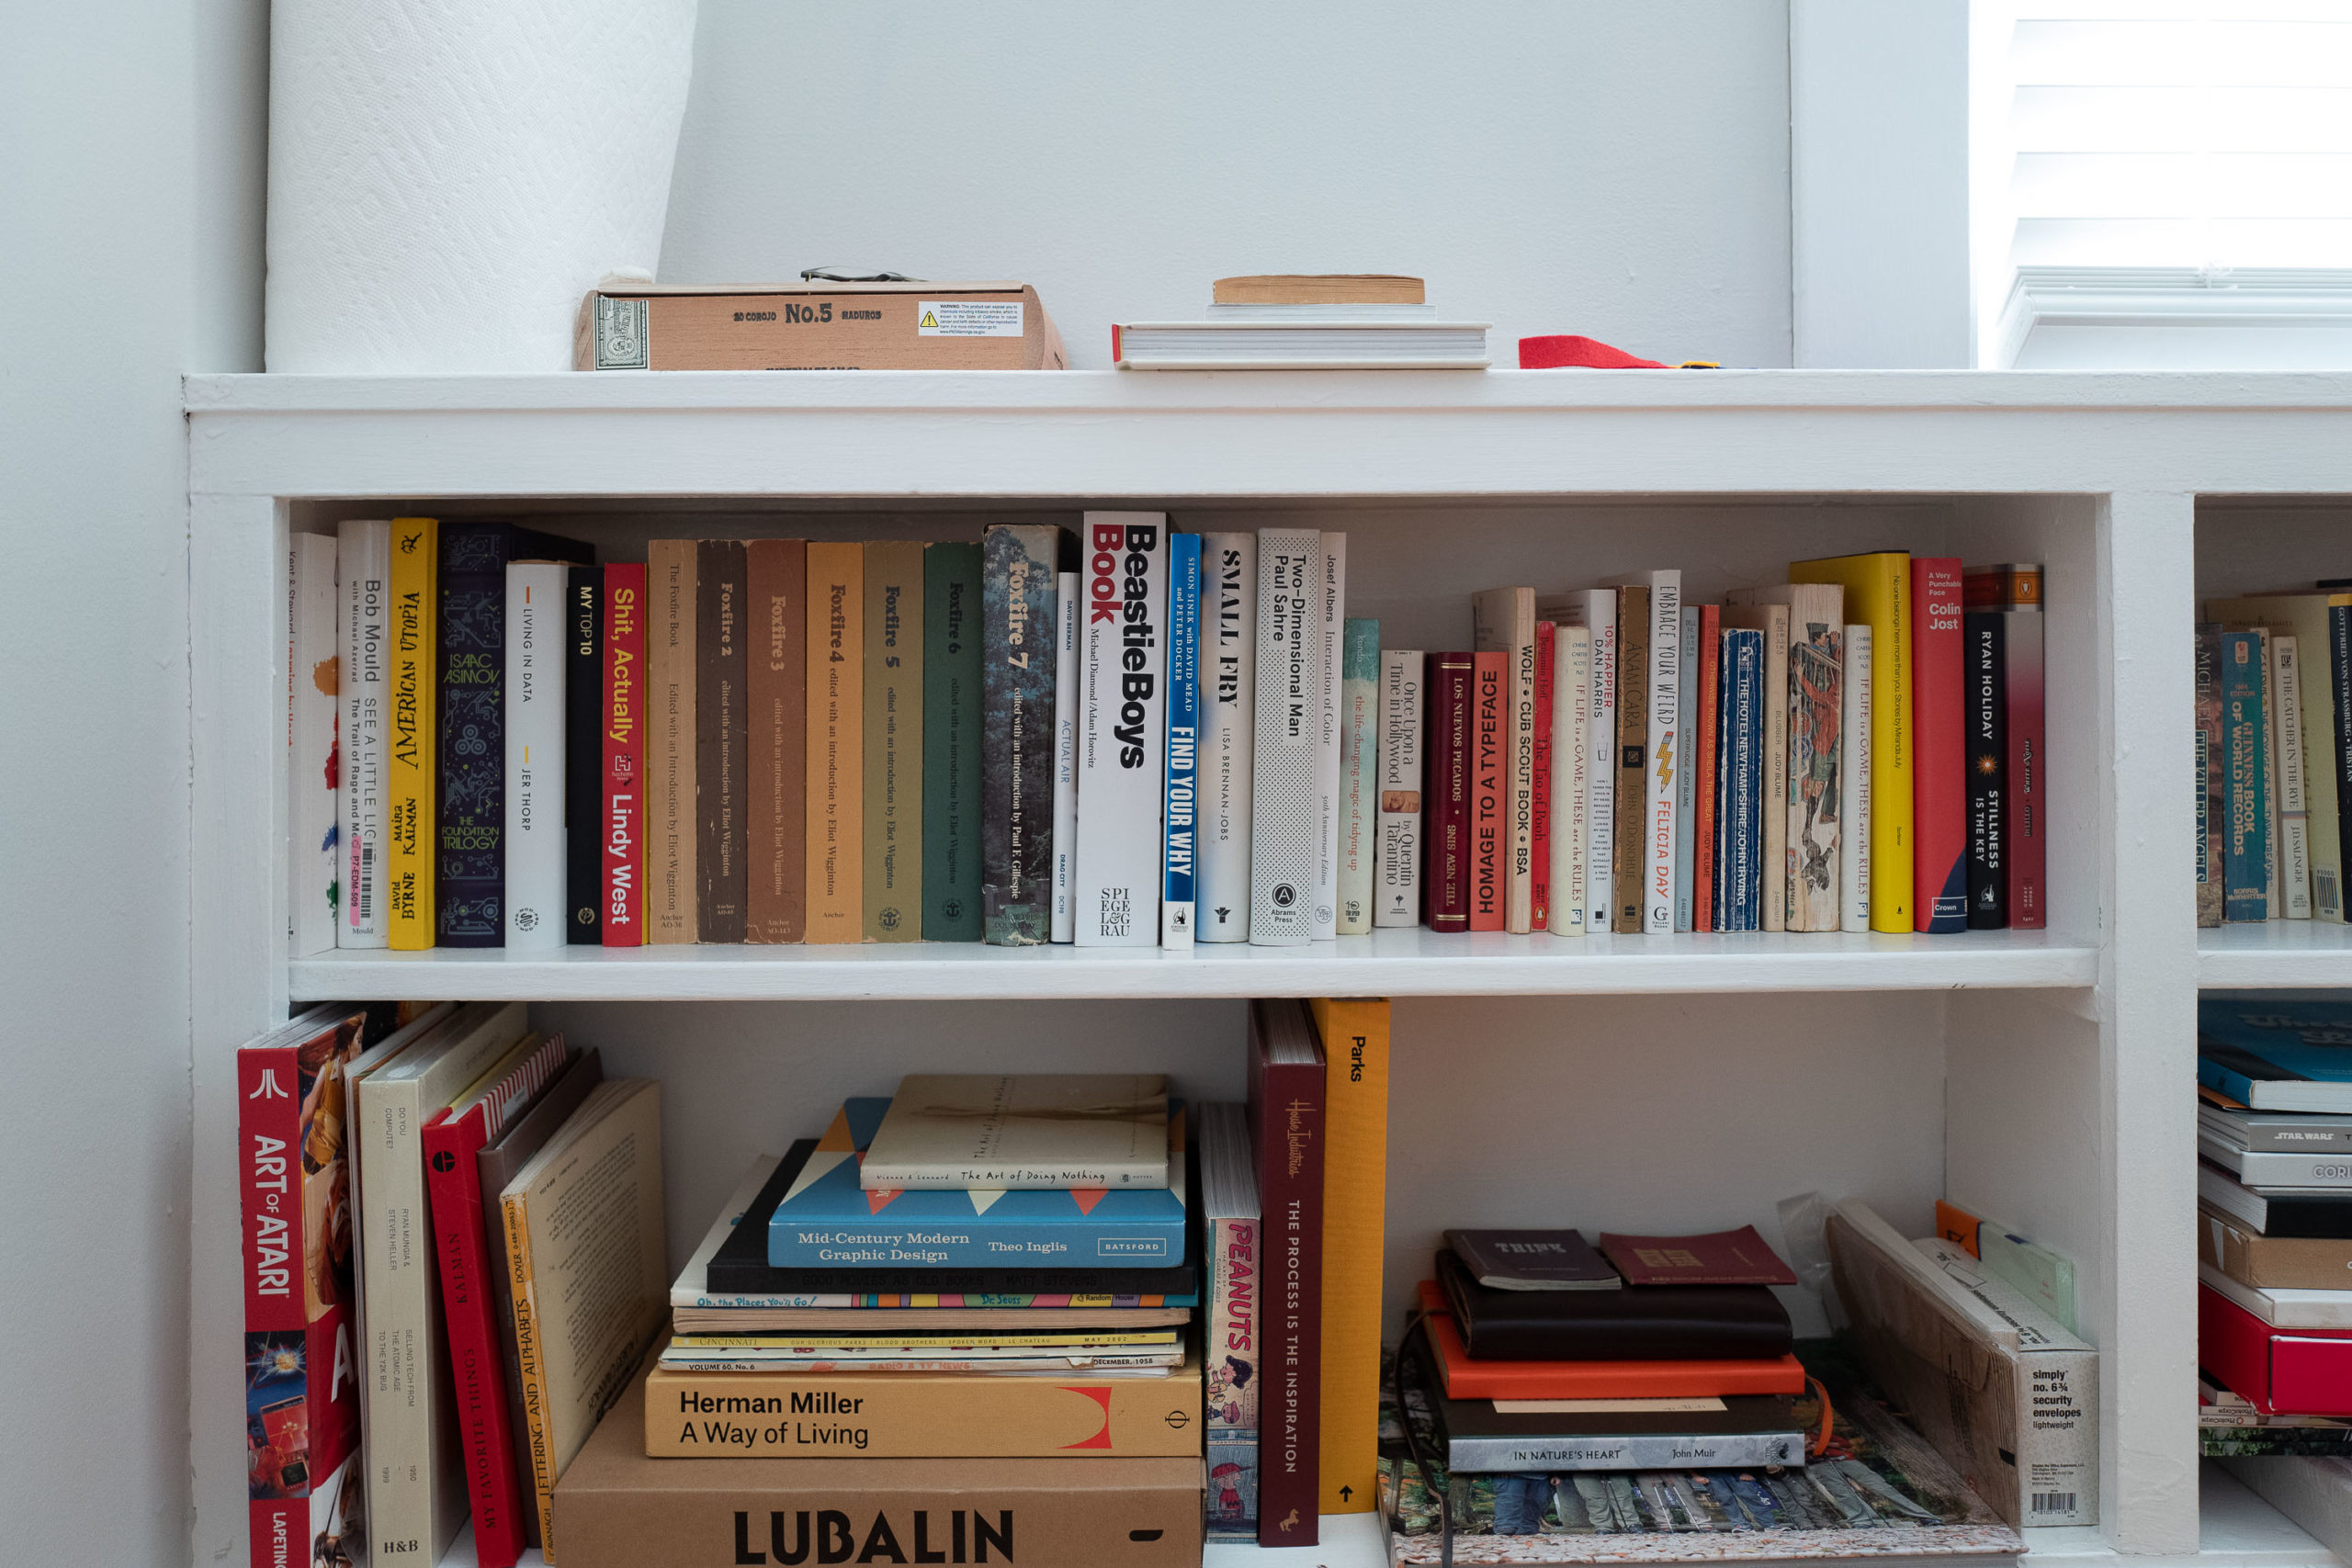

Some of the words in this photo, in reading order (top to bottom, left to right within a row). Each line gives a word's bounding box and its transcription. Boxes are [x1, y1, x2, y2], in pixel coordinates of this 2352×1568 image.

[669, 565, 679, 583] The
[1274, 555, 1289, 589] Paul
[365, 580, 380, 617] Bob
[580, 586, 593, 608] MY
[669, 586, 679, 620] Foxfire
[1221, 549, 1241, 646] SMALL
[1657, 586, 1679, 638] EMBRACE
[1929, 603, 1962, 615] Colin
[580, 612, 593, 638] TOP
[610, 587, 635, 641] Shit,
[830, 584, 845, 649] Foxfire
[885, 586, 900, 648] Foxfire
[1272, 593, 1288, 642] Sahre
[1288, 554, 1306, 698] Two-Dimensional
[1929, 618, 1958, 630] Jost
[522, 608, 533, 651] LIVING
[669, 622, 679, 648] Book
[1604, 626, 1613, 648] 10%
[365, 625, 380, 682] Mould
[449, 653, 492, 669] ISAAC
[522, 655, 533, 668] IN
[580, 641, 593, 656] 10
[829, 650, 845, 663] 4
[1114, 525, 1157, 769] BeastieBoys
[1594, 639, 1603, 666] DAN
[1657, 646, 1677, 676] YOUR
[1981, 631, 1992, 670] RYAN
[443, 669, 500, 684] ASIMOV
[885, 657, 899, 668] 5
[1521, 645, 1532, 685] WOLF
[522, 672, 533, 703] DATA
[829, 668, 838, 697] edited
[1218, 656, 1238, 709] FRY
[1389, 663, 1404, 695] Time
[1603, 653, 1612, 708] HAPPIER
[2197, 650, 2211, 725] MICHAEL
[608, 648, 634, 744] Actually
[669, 683, 679, 714] Edited
[887, 687, 896, 712] edited
[1389, 699, 1403, 711] in
[1404, 682, 1417, 716] Once
[1593, 671, 1602, 718] HARRIS
[1657, 683, 1676, 725] WEIRD
[1982, 675, 1993, 739] HOLIDAY
[365, 698, 377, 728] SEE
[829, 701, 838, 722] with
[887, 716, 896, 735] with
[1288, 704, 1303, 737] Man
[1480, 671, 1498, 772] TYPEFACE
[1520, 702, 1532, 731] CUB
[2232, 701, 2242, 721] OF
[365, 735, 377, 745] A
[669, 716, 679, 738] with
[829, 726, 836, 738] an
[1222, 728, 1231, 750] LISA
[1398, 719, 1416, 753] Upon
[668, 740, 675, 752] an
[888, 738, 894, 749] an
[1170, 727, 1194, 770] FIND
[1385, 715, 1403, 784] Hollywood
[2233, 725, 2243, 780] WORLD
[2243, 722, 2254, 786] GUINNESS
[828, 741, 838, 800] introduction
[1404, 757, 1413, 765] a
[1518, 735, 1532, 785] SCOUT
[365, 752, 377, 807] LITTLE
[521, 768, 531, 790] JER
[668, 755, 679, 817] Introduction
[887, 751, 896, 804] introduction
[1480, 776, 1495, 791] A
[521, 793, 531, 831] THORP
[825, 804, 837, 816] by
[885, 807, 896, 817] by
[1170, 777, 1193, 826] YOUR
[1220, 755, 1230, 841] BRENNAN-JOBS
[1479, 796, 1496, 821] TO
[1517, 790, 1530, 831] BOOK
[1975, 797, 1984, 808] IS
[2244, 790, 2255, 833] BOOK
[402, 798, 416, 857] KALMAN
[442, 827, 499, 836] FOUNDATION
[608, 794, 633, 858] Lindy
[666, 820, 678, 831] by
[828, 819, 837, 842] Eliot
[887, 820, 896, 841] Eliot
[1402, 820, 1412, 832] by
[1656, 801, 1671, 859] FELICIA
[1975, 812, 1984, 835] THE
[1988, 790, 1998, 869] STILLNESS
[2233, 783, 2244, 856] RECORDS
[443, 836, 499, 851] TRILOGY
[668, 834, 678, 857] Eliot
[1168, 832, 1192, 875] WHY
[1385, 822, 1400, 886] Tarantino
[1975, 839, 1984, 862] KEY
[825, 845, 837, 897] Wigginton
[885, 844, 896, 889] Wigginton
[1400, 833, 1415, 887] Quentin
[1478, 828, 1495, 914] HOMAGE
[1516, 847, 1528, 875] BSA
[401, 872, 415, 919] BYRNE
[612, 864, 632, 925] West
[666, 859, 678, 910] Wigginton
[1655, 866, 1669, 899] DAY
[1101, 924, 1130, 937] RAU
[1350, 1035, 1366, 1083] Parks
[398, 1120, 407, 1135] YOU
[399, 1107, 406, 1118] DO
[1285, 1098, 1317, 1131] House
[1286, 1129, 1312, 1179] Industries
[961, 1171, 982, 1182] The
[985, 1171, 1004, 1181] Art
[1010, 1171, 1023, 1182] of
[1027, 1171, 1056, 1184] Doing
[1062, 1171, 1105, 1184] Nothing
[388, 1209, 397, 1238] STEVEN
[1288, 1200, 1300, 1230] THE
[797, 1233, 902, 1247] Mid-Century
[906, 1233, 970, 1245] Modern
[988, 1242, 1023, 1252] Theo
[1026, 1242, 1068, 1255] Inglis
[389, 1241, 398, 1271] HELLER
[818, 1249, 886, 1263] Graphic
[889, 1249, 949, 1264] Design
[1227, 1223, 1254, 1351] PEANUTS
[1287, 1236, 1299, 1309] PROCESS
[1287, 1315, 1298, 1328] IS
[405, 1329, 414, 1360] SELLING
[1286, 1335, 1298, 1365] THE
[406, 1363, 414, 1383] TECH
[2032, 1369, 2065, 1383] simply
[407, 1385, 415, 1406] FROM
[680, 1392, 783, 1415] Herman
[789, 1392, 863, 1414] Miller
[2032, 1394, 2073, 1409] security
[1284, 1371, 1297, 1472] INSPIRATION
[2032, 1407, 2082, 1422] envelopes
[2032, 1420, 2075, 1433] lightweight
[680, 1424, 698, 1444] A
[703, 1424, 757, 1449] Way
[763, 1423, 786, 1444] of
[797, 1423, 869, 1450] Living
[1514, 1450, 1528, 1461] IN
[1530, 1450, 1584, 1461] NATURE'S
[1586, 1450, 1622, 1461] HEART
[1672, 1448, 1691, 1461] John
[1693, 1449, 1716, 1460] Muir
[383, 1540, 419, 1553] H&B
[735, 1509, 1014, 1565] LUBALIN
